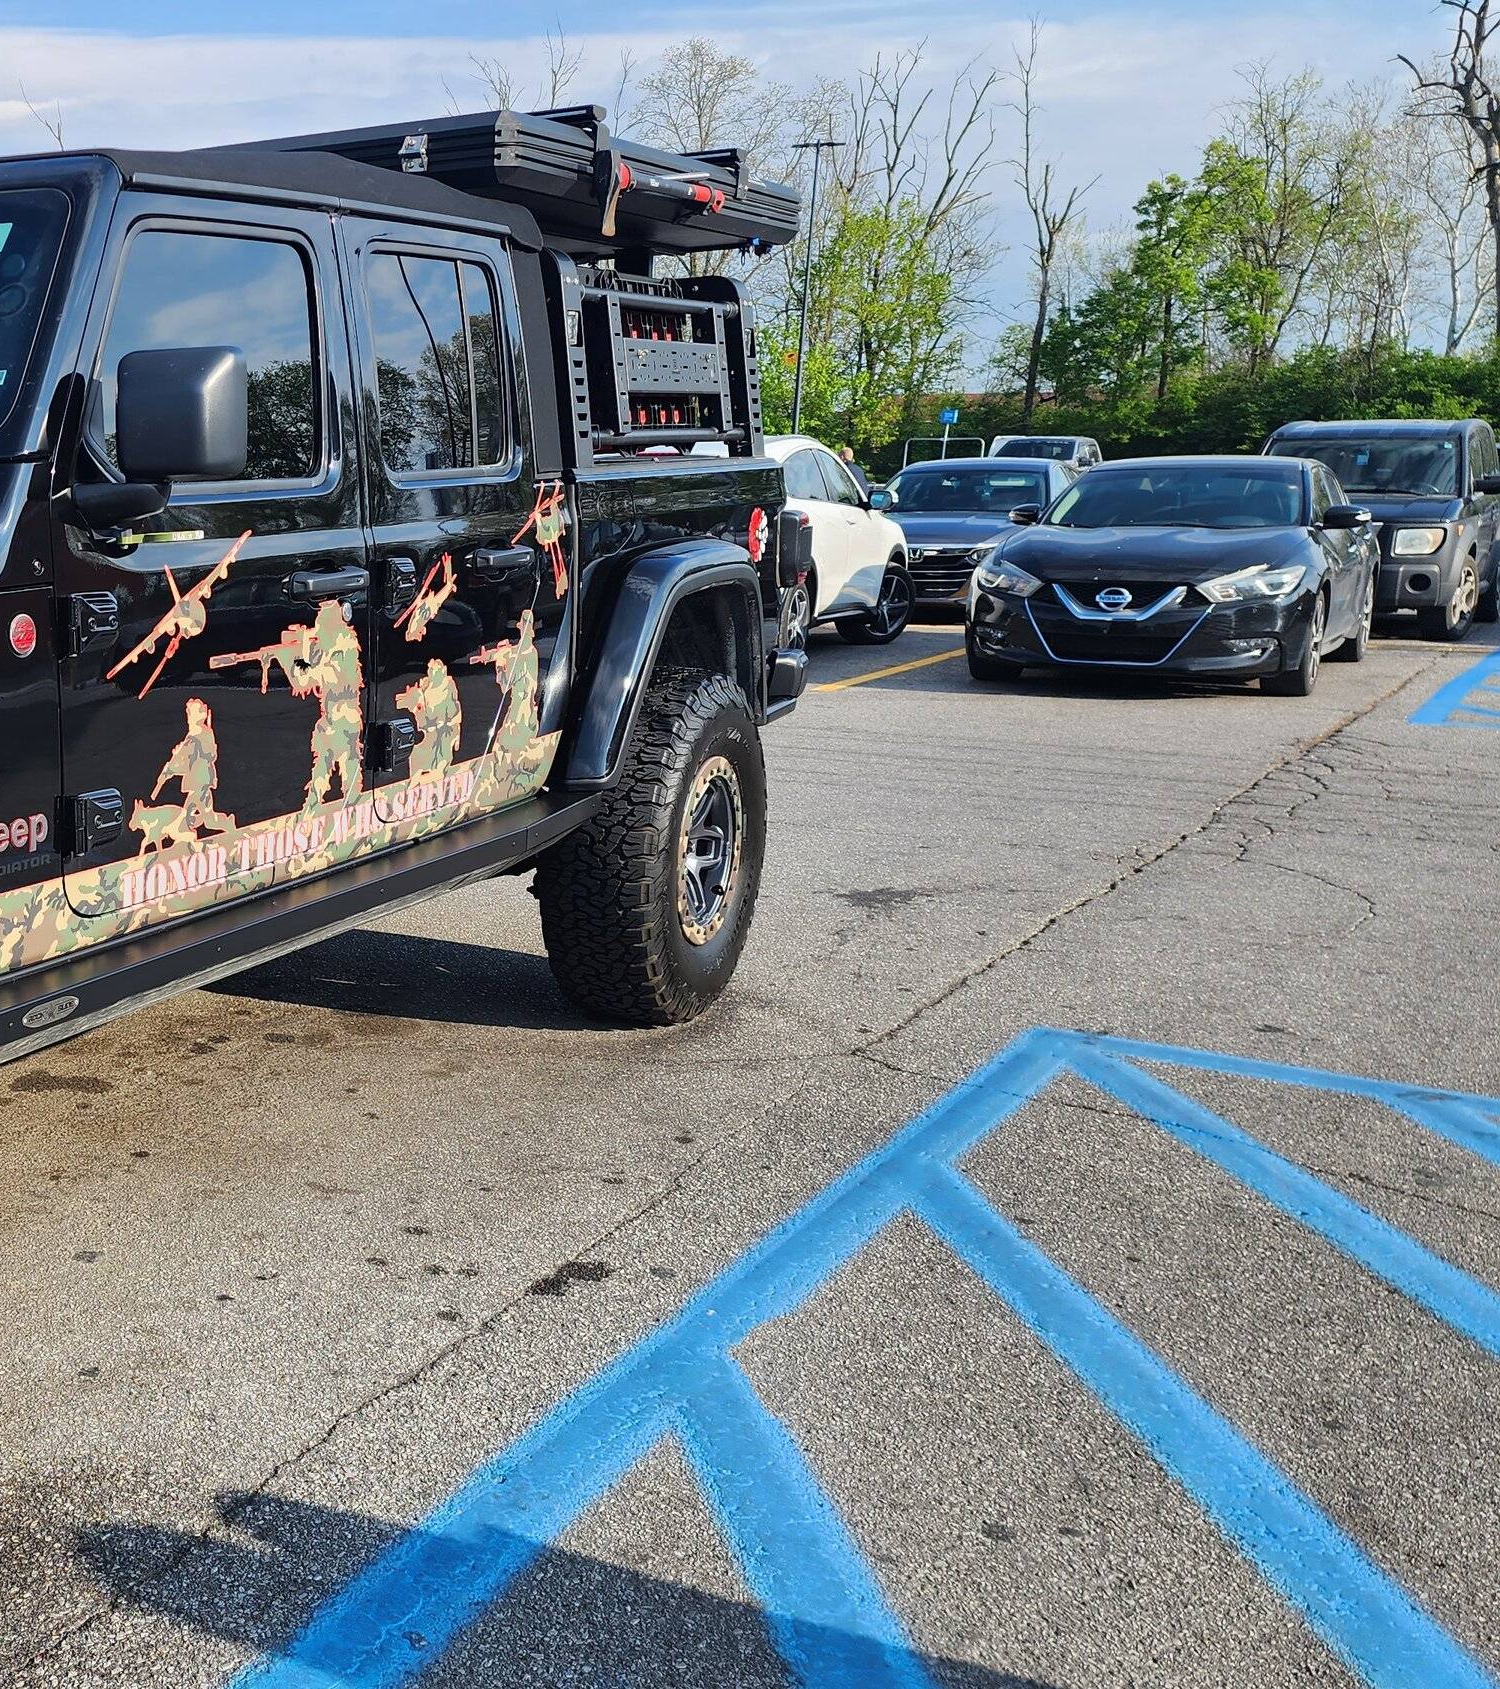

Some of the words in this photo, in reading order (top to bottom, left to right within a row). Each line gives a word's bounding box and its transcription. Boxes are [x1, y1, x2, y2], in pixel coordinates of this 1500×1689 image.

[120, 846, 229, 911] HONOR
[236, 816, 326, 872] THOSE
[332, 802, 388, 846] WHO
[391, 769, 480, 824] SERVED
